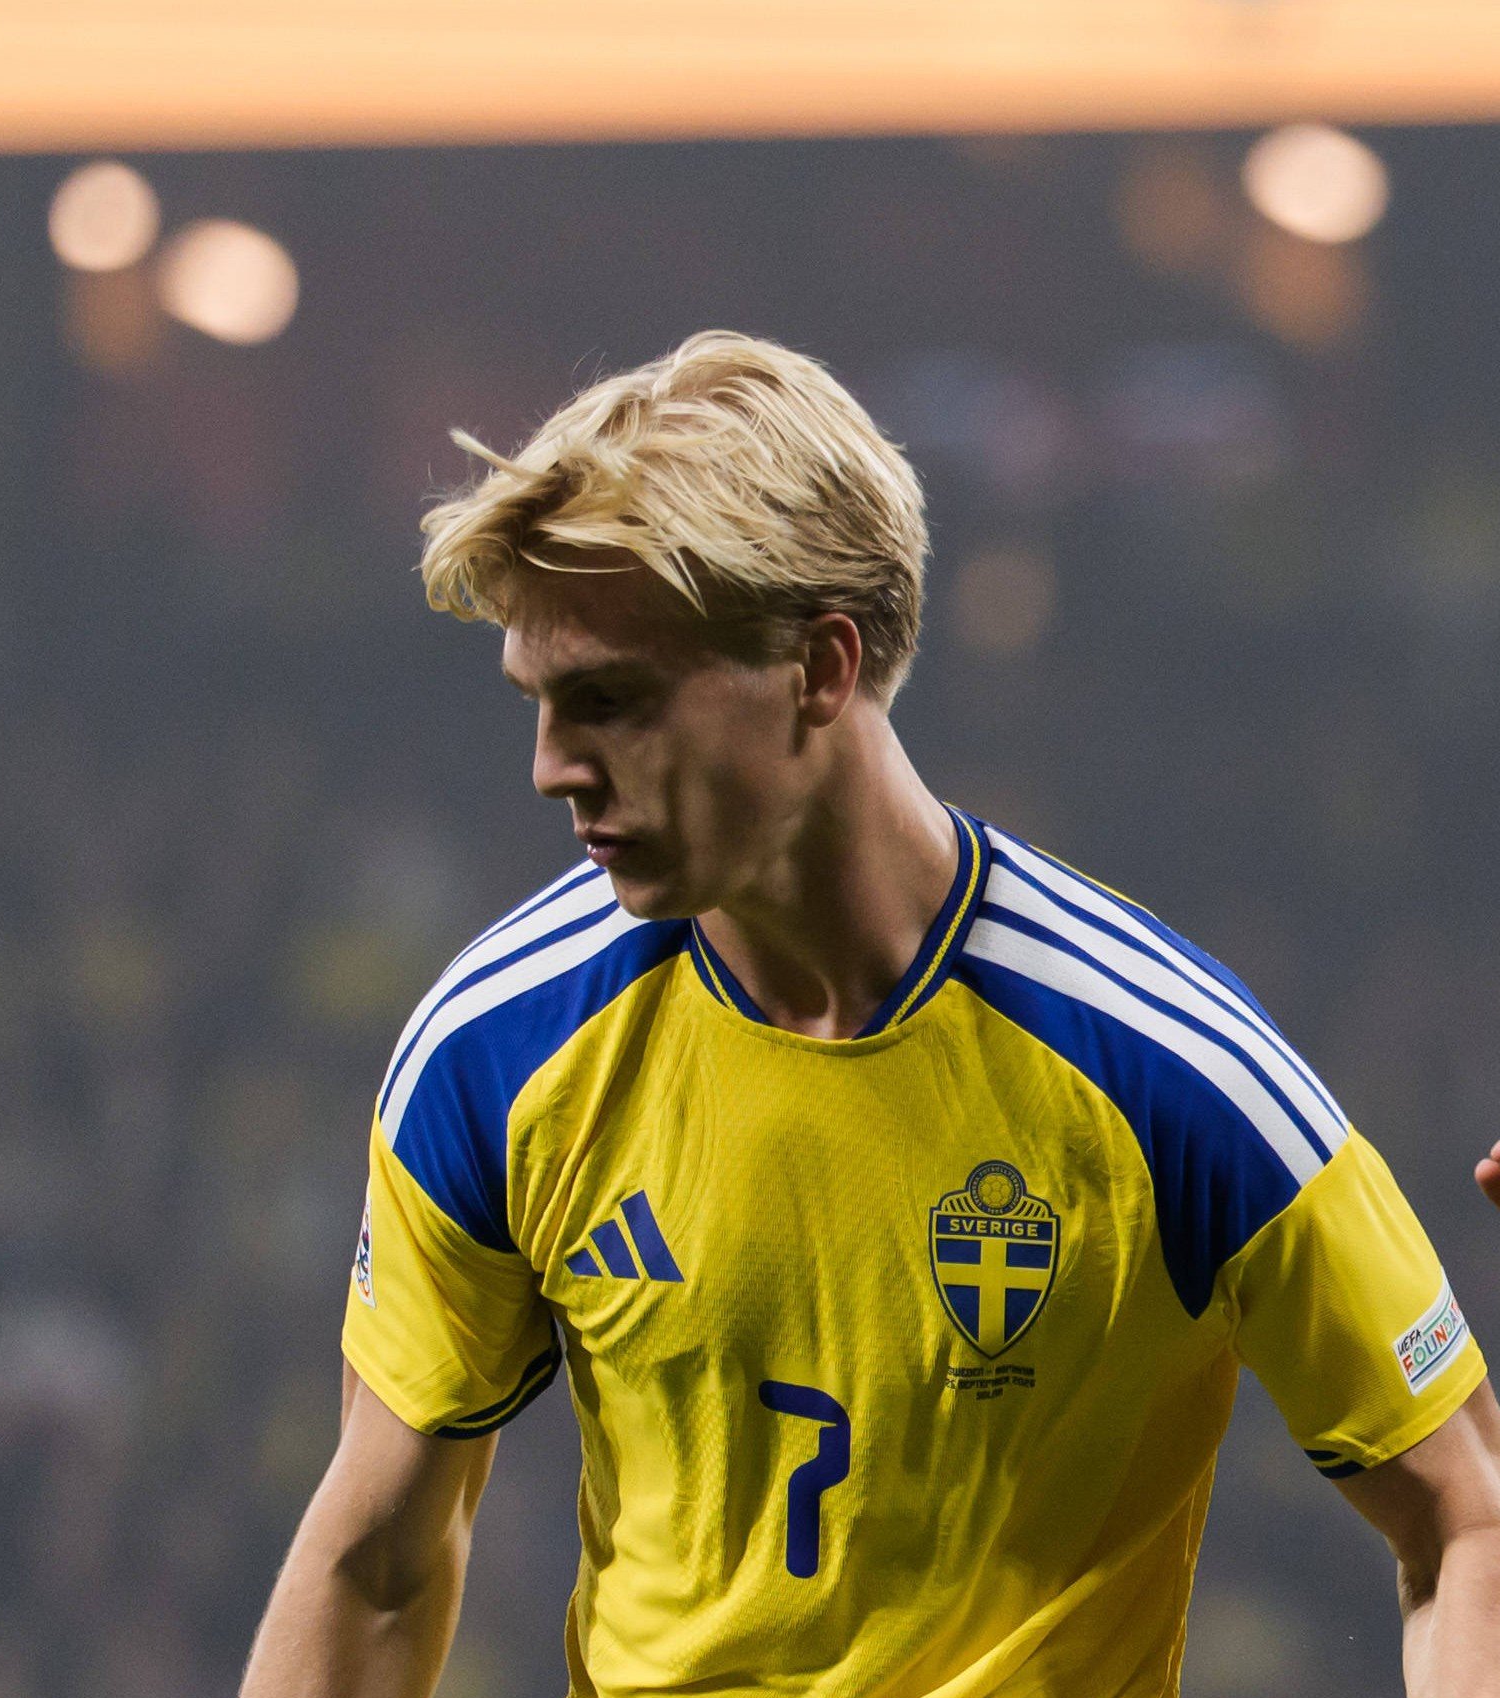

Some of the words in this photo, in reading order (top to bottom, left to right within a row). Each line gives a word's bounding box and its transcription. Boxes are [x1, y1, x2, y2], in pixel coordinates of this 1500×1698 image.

[949, 1218, 1039, 1238] SVERIGE
[1397, 1328, 1422, 1357] UEFA
[758, 1379, 852, 1579] 7
